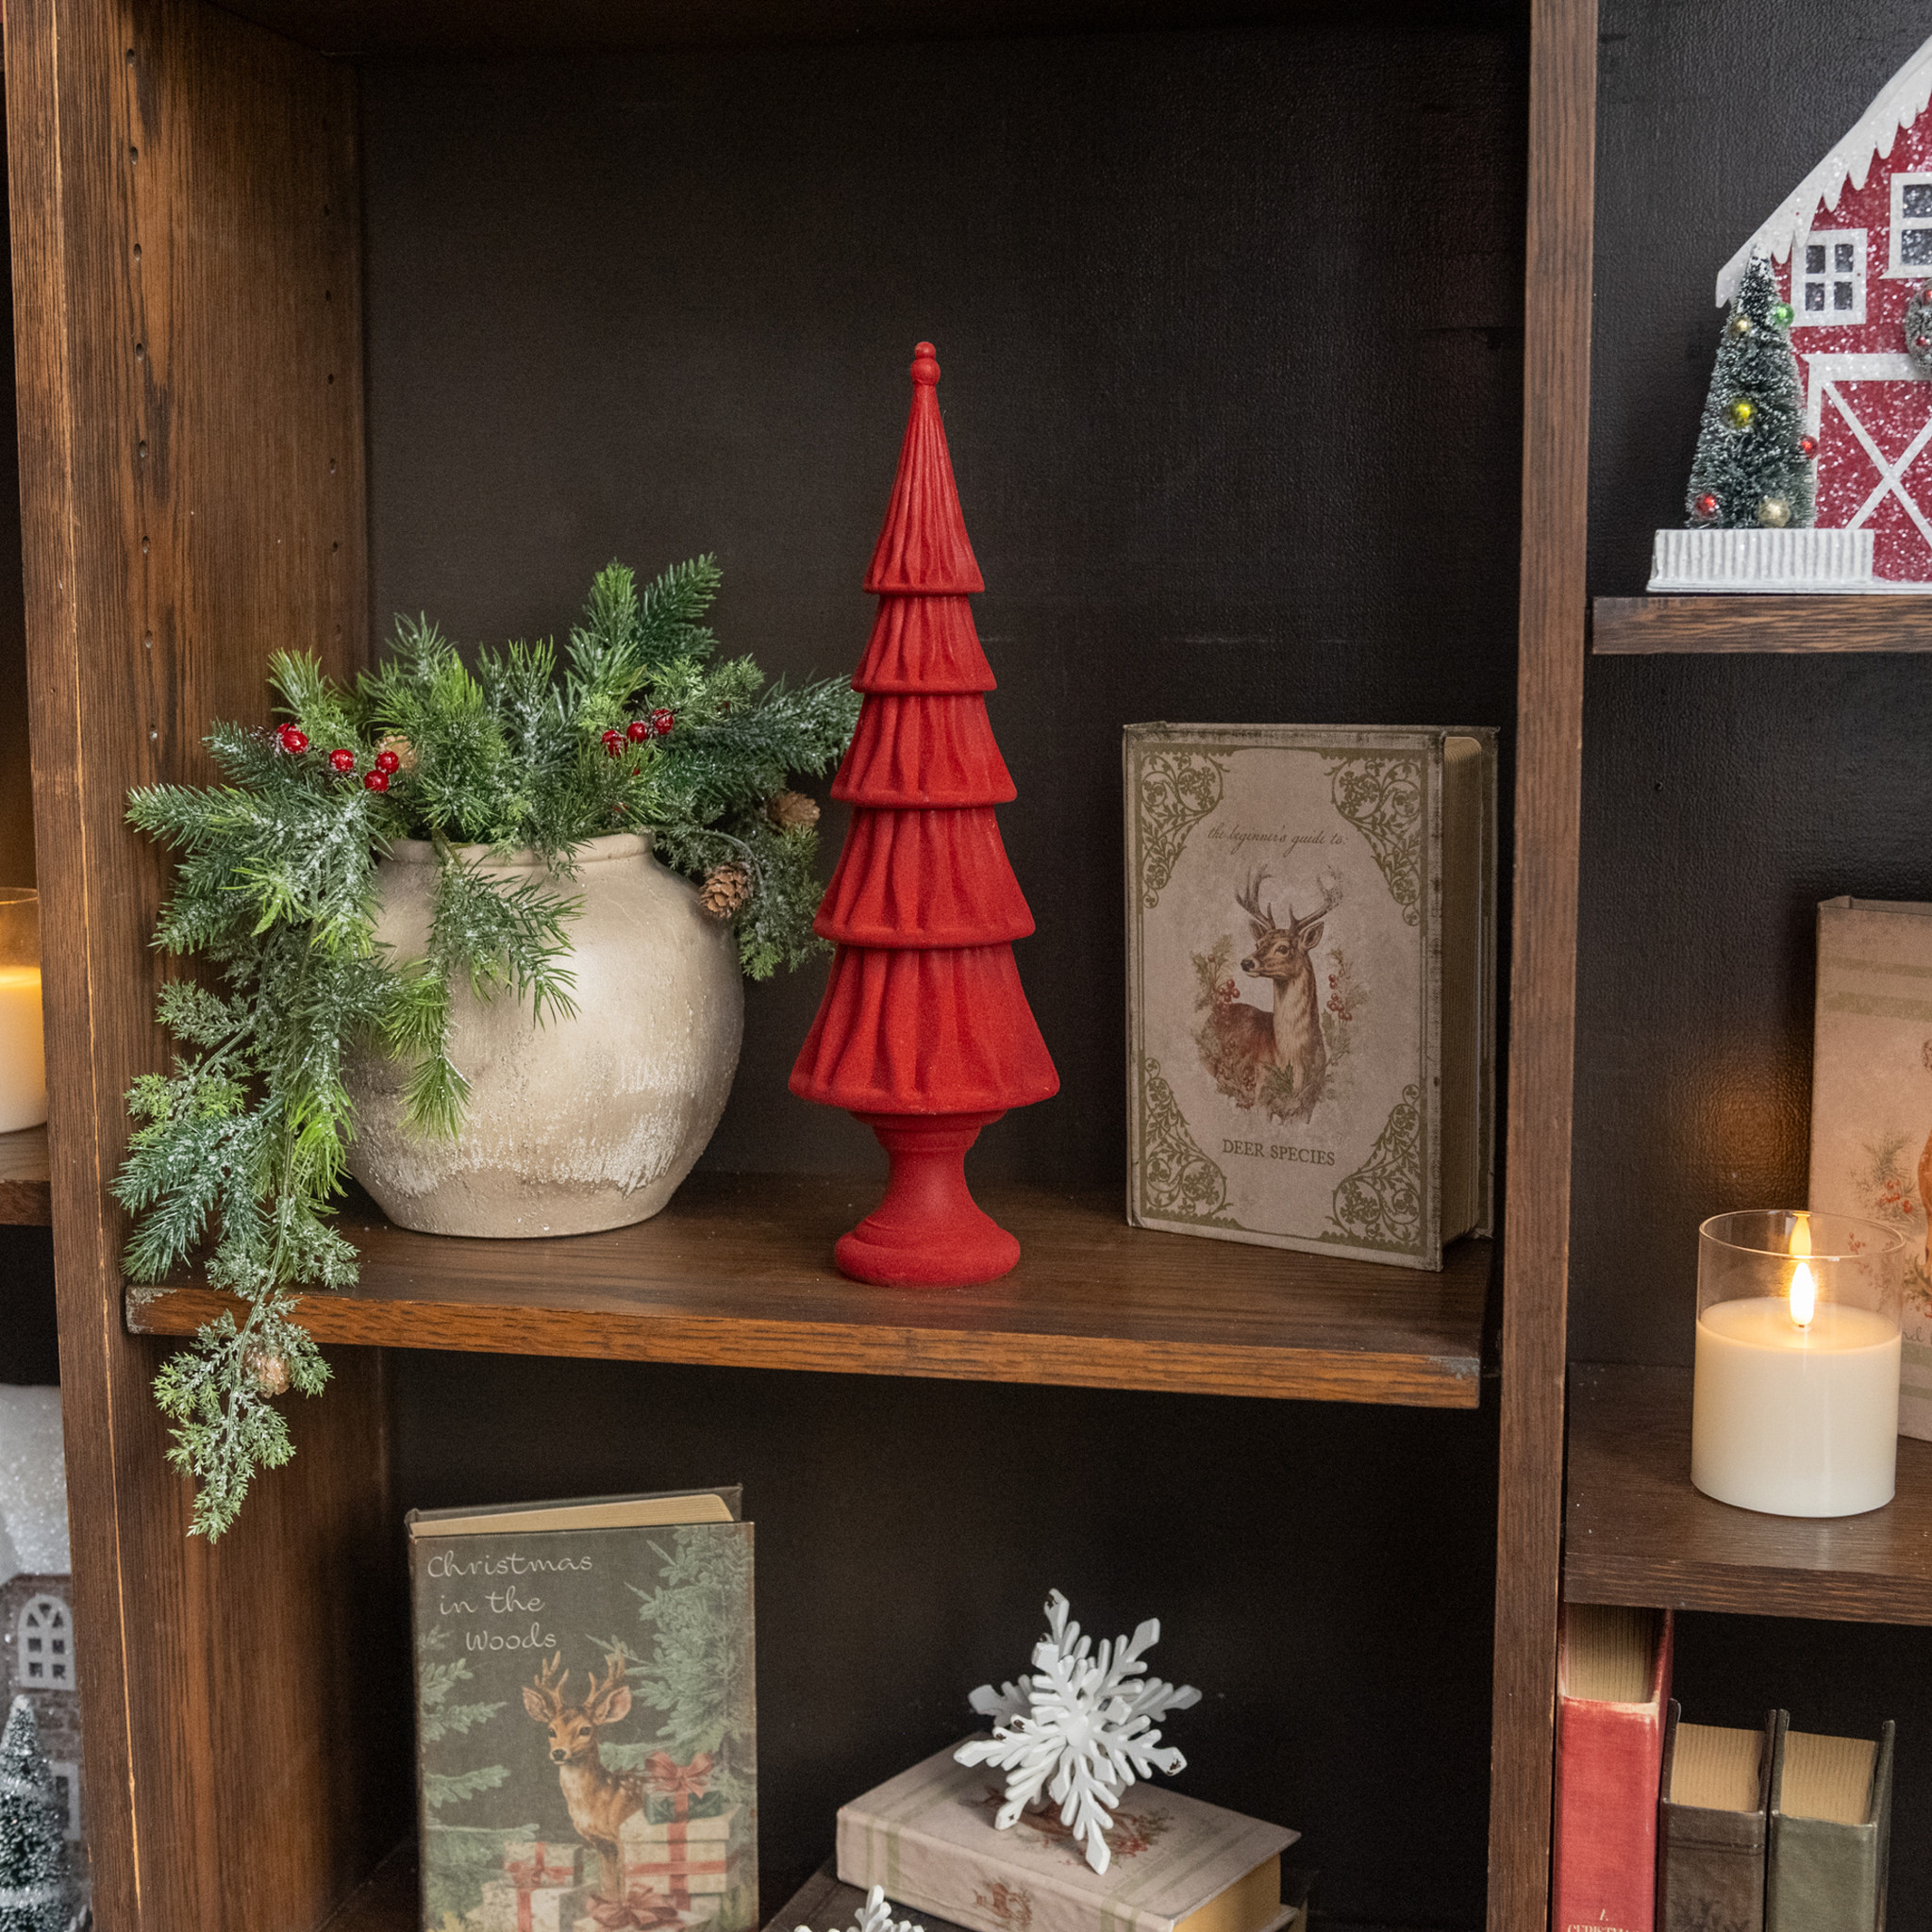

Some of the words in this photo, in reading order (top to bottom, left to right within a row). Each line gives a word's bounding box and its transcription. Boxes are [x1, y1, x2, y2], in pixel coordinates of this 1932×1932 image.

[1208, 823, 1224, 840] the
[1226, 824, 1287, 855] beginner's
[1283, 829, 1325, 858] guide
[1222, 1139, 1265, 1158] DEER
[1270, 1144, 1336, 1167] SPECIES
[427, 1550, 593, 1577] Christmas
[440, 1594, 476, 1615] in
[485, 1585, 546, 1613] the
[466, 1622, 558, 1651] Woods
